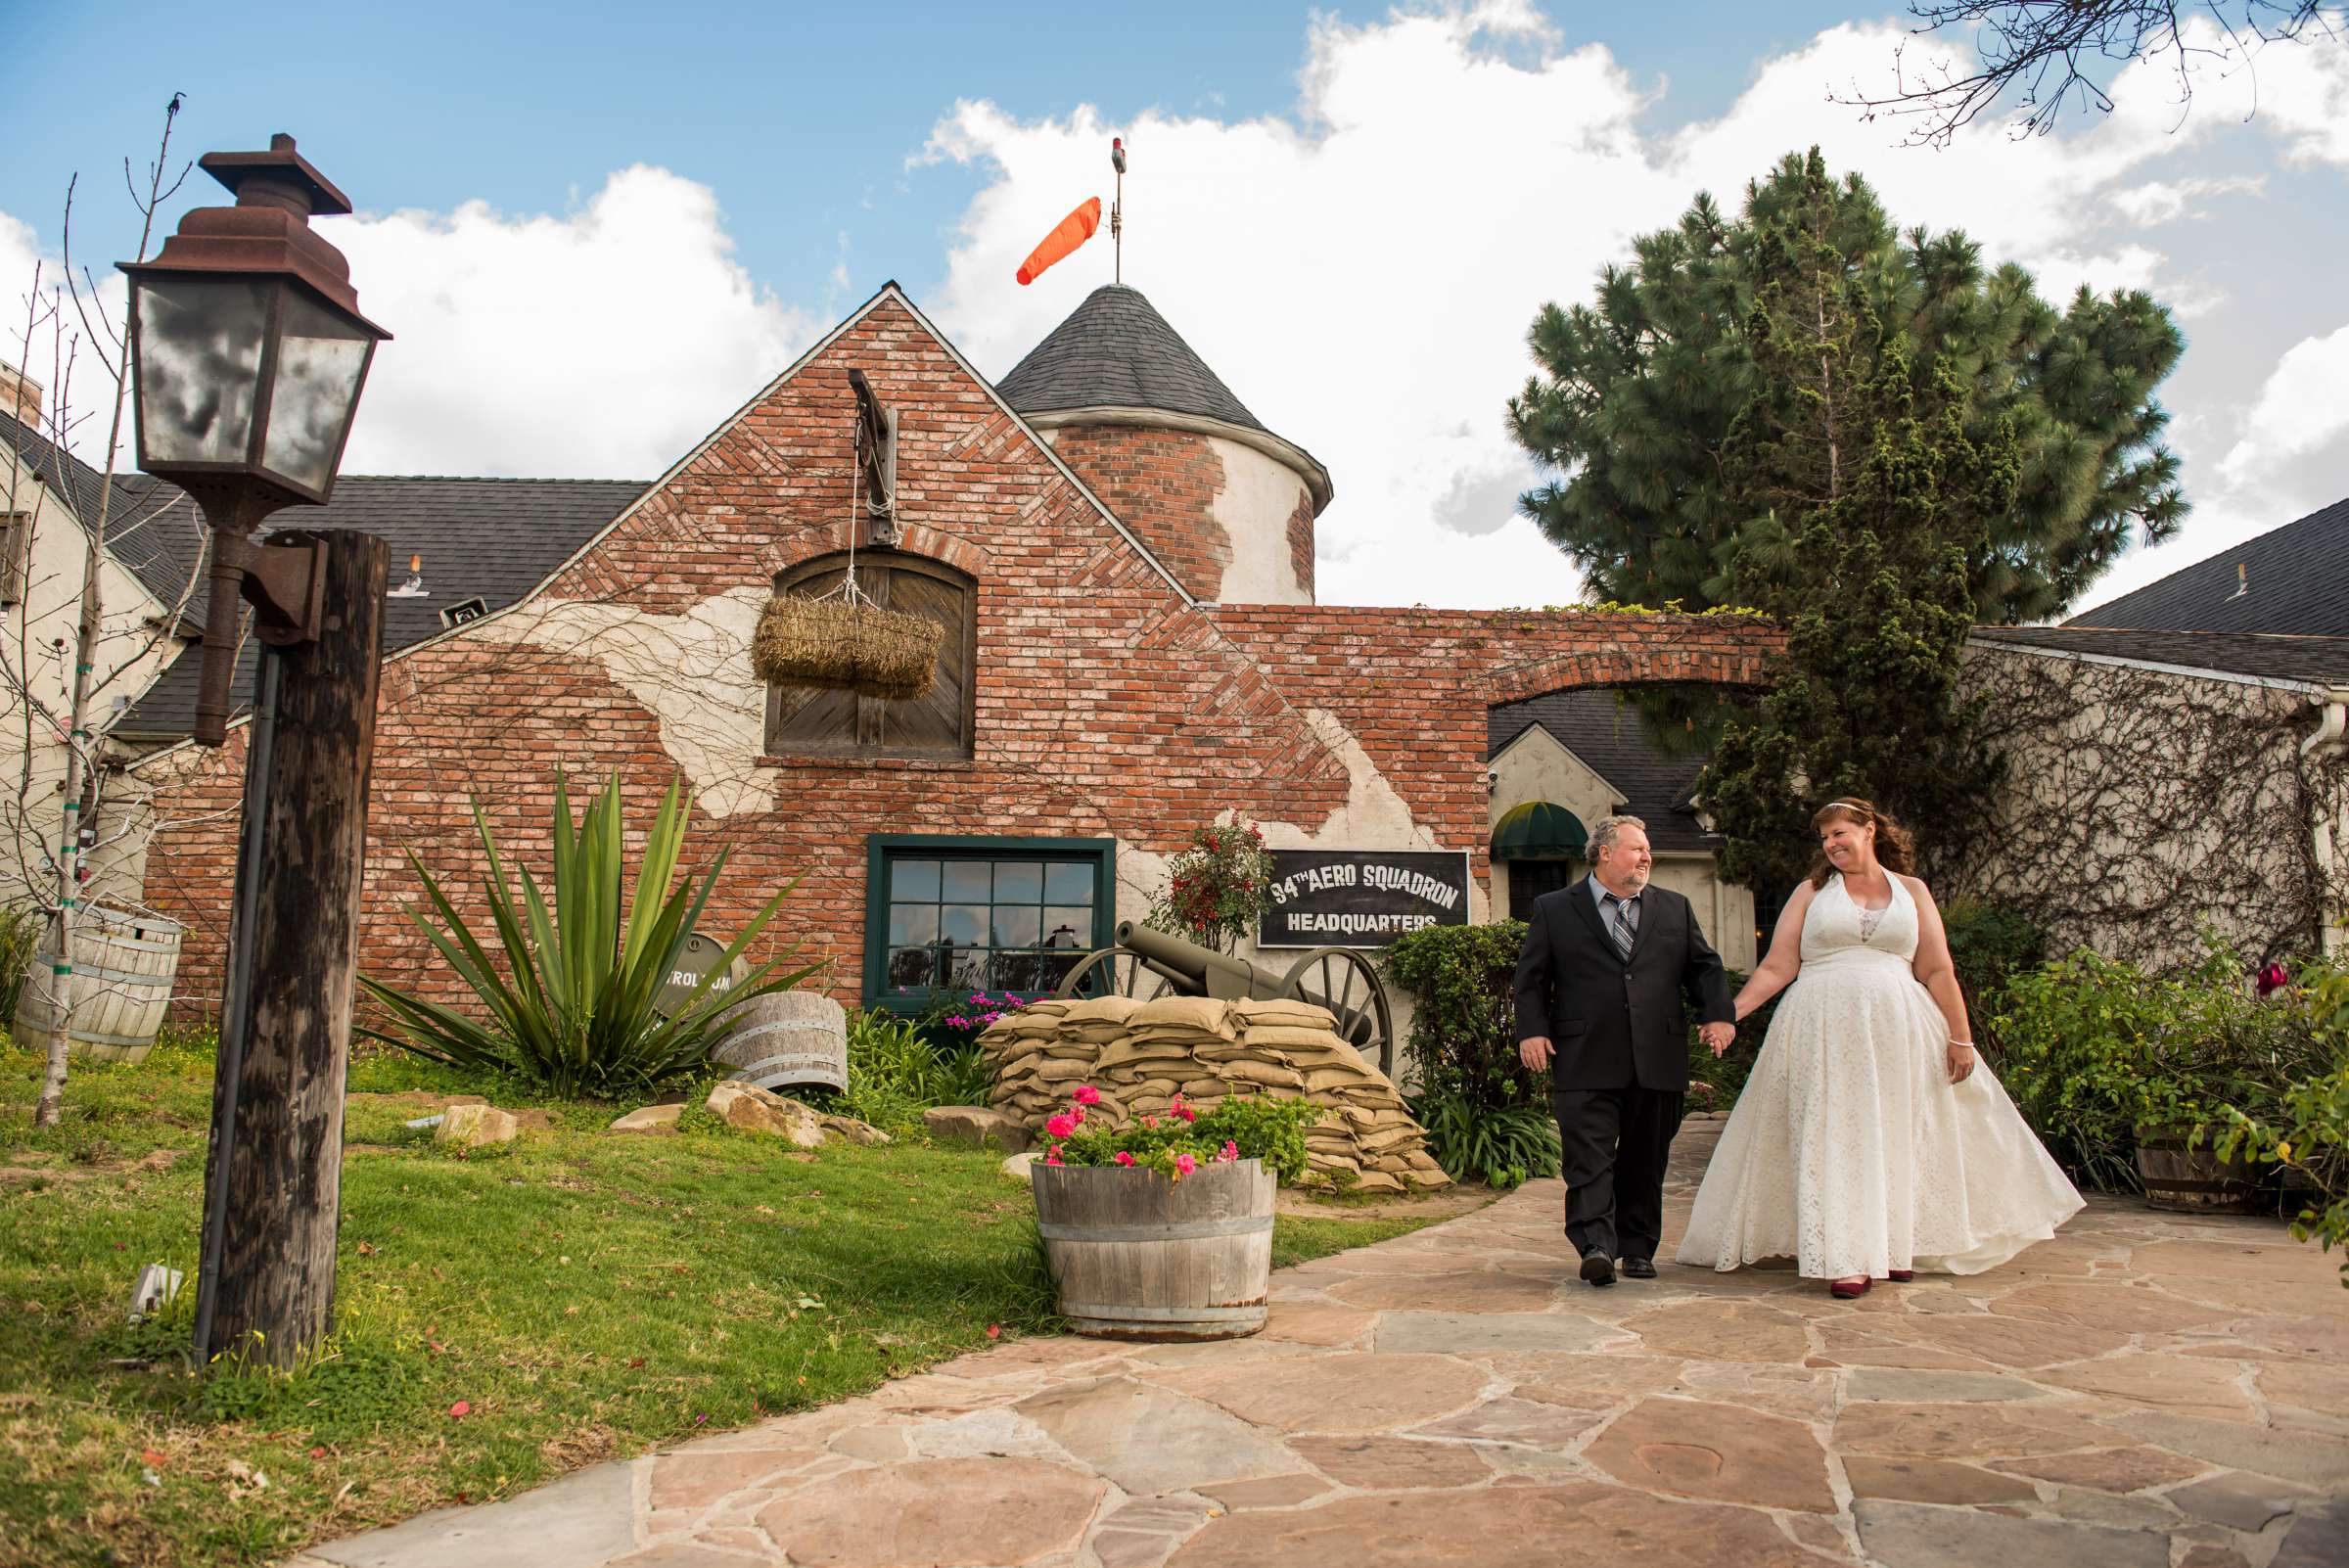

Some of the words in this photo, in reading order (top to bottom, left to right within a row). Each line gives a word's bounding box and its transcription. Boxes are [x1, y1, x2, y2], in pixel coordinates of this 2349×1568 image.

[1270, 870, 1309, 904] 94TH
[1309, 864, 1357, 893] AERO
[1362, 864, 1459, 910] SQUADRON
